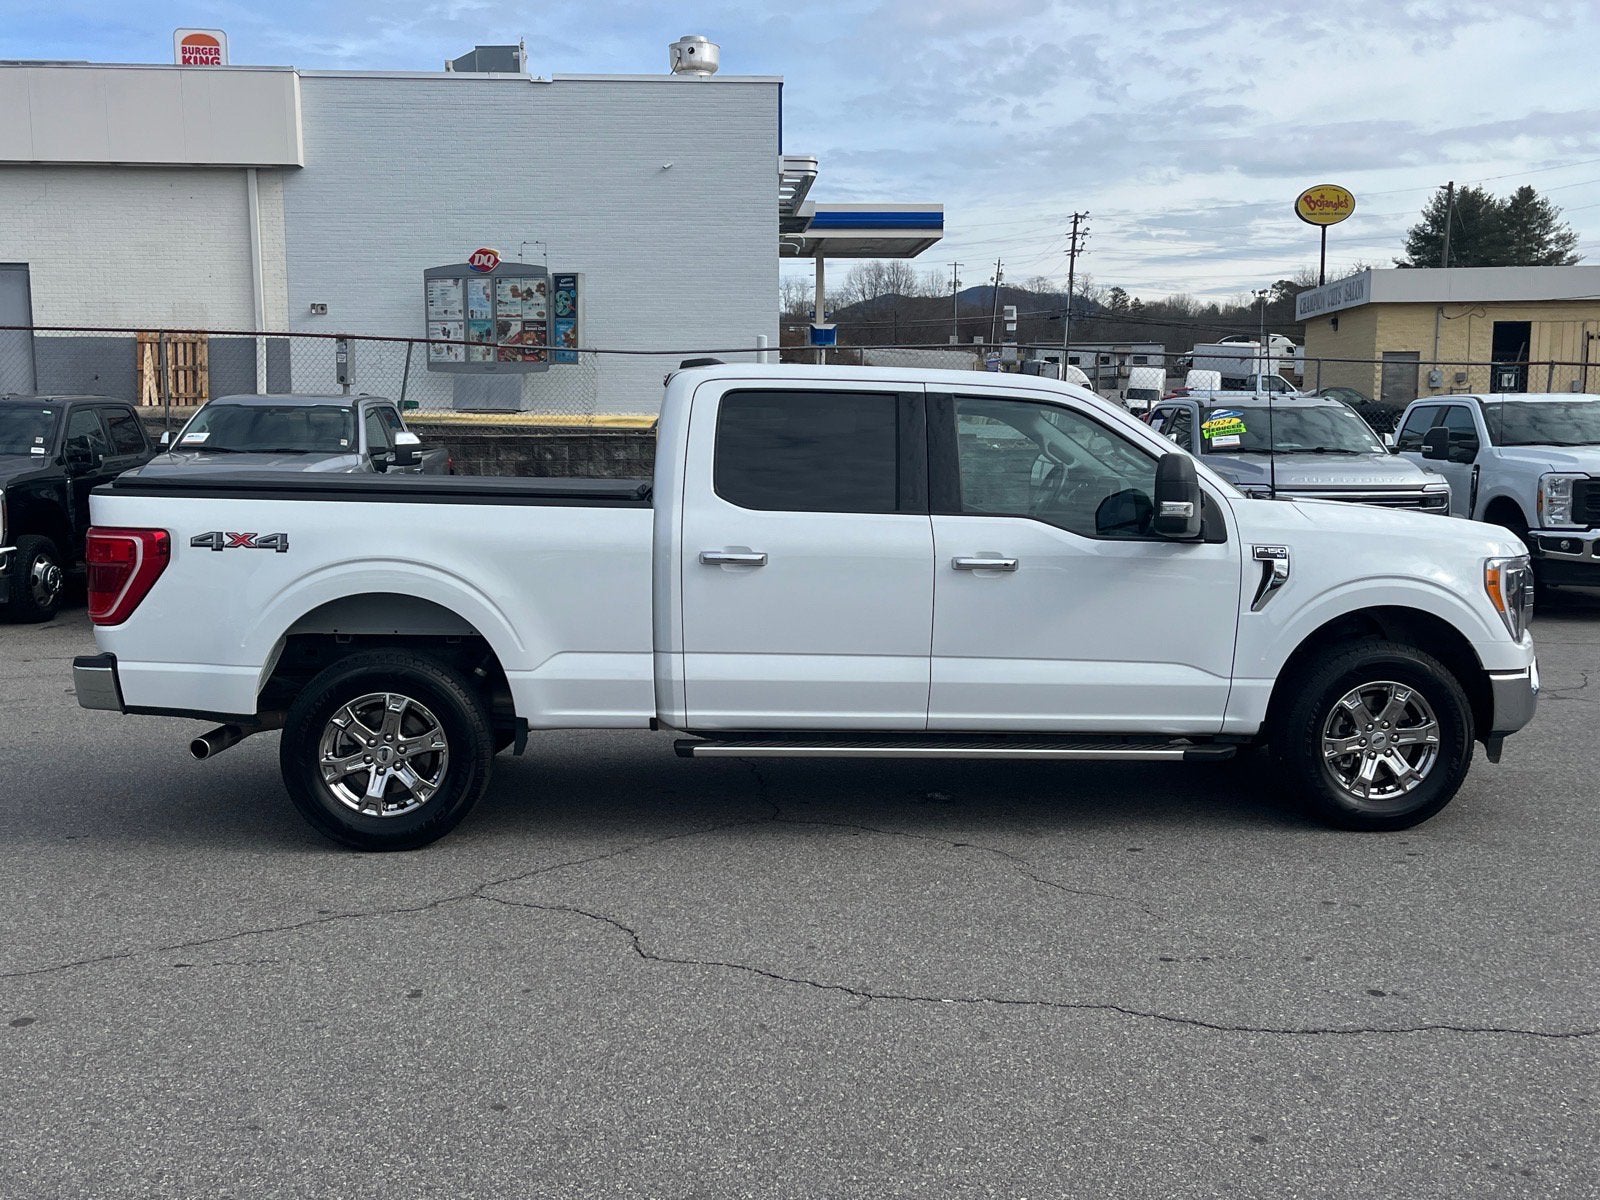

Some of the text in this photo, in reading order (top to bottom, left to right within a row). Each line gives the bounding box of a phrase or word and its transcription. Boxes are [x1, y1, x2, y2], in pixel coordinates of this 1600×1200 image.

[181, 46, 220, 56] BURGER
[182, 55, 221, 65] KING
[473, 253, 496, 268] DQ
[1344, 279, 1365, 303] SALON
[1208, 418, 1233, 428] 2024
